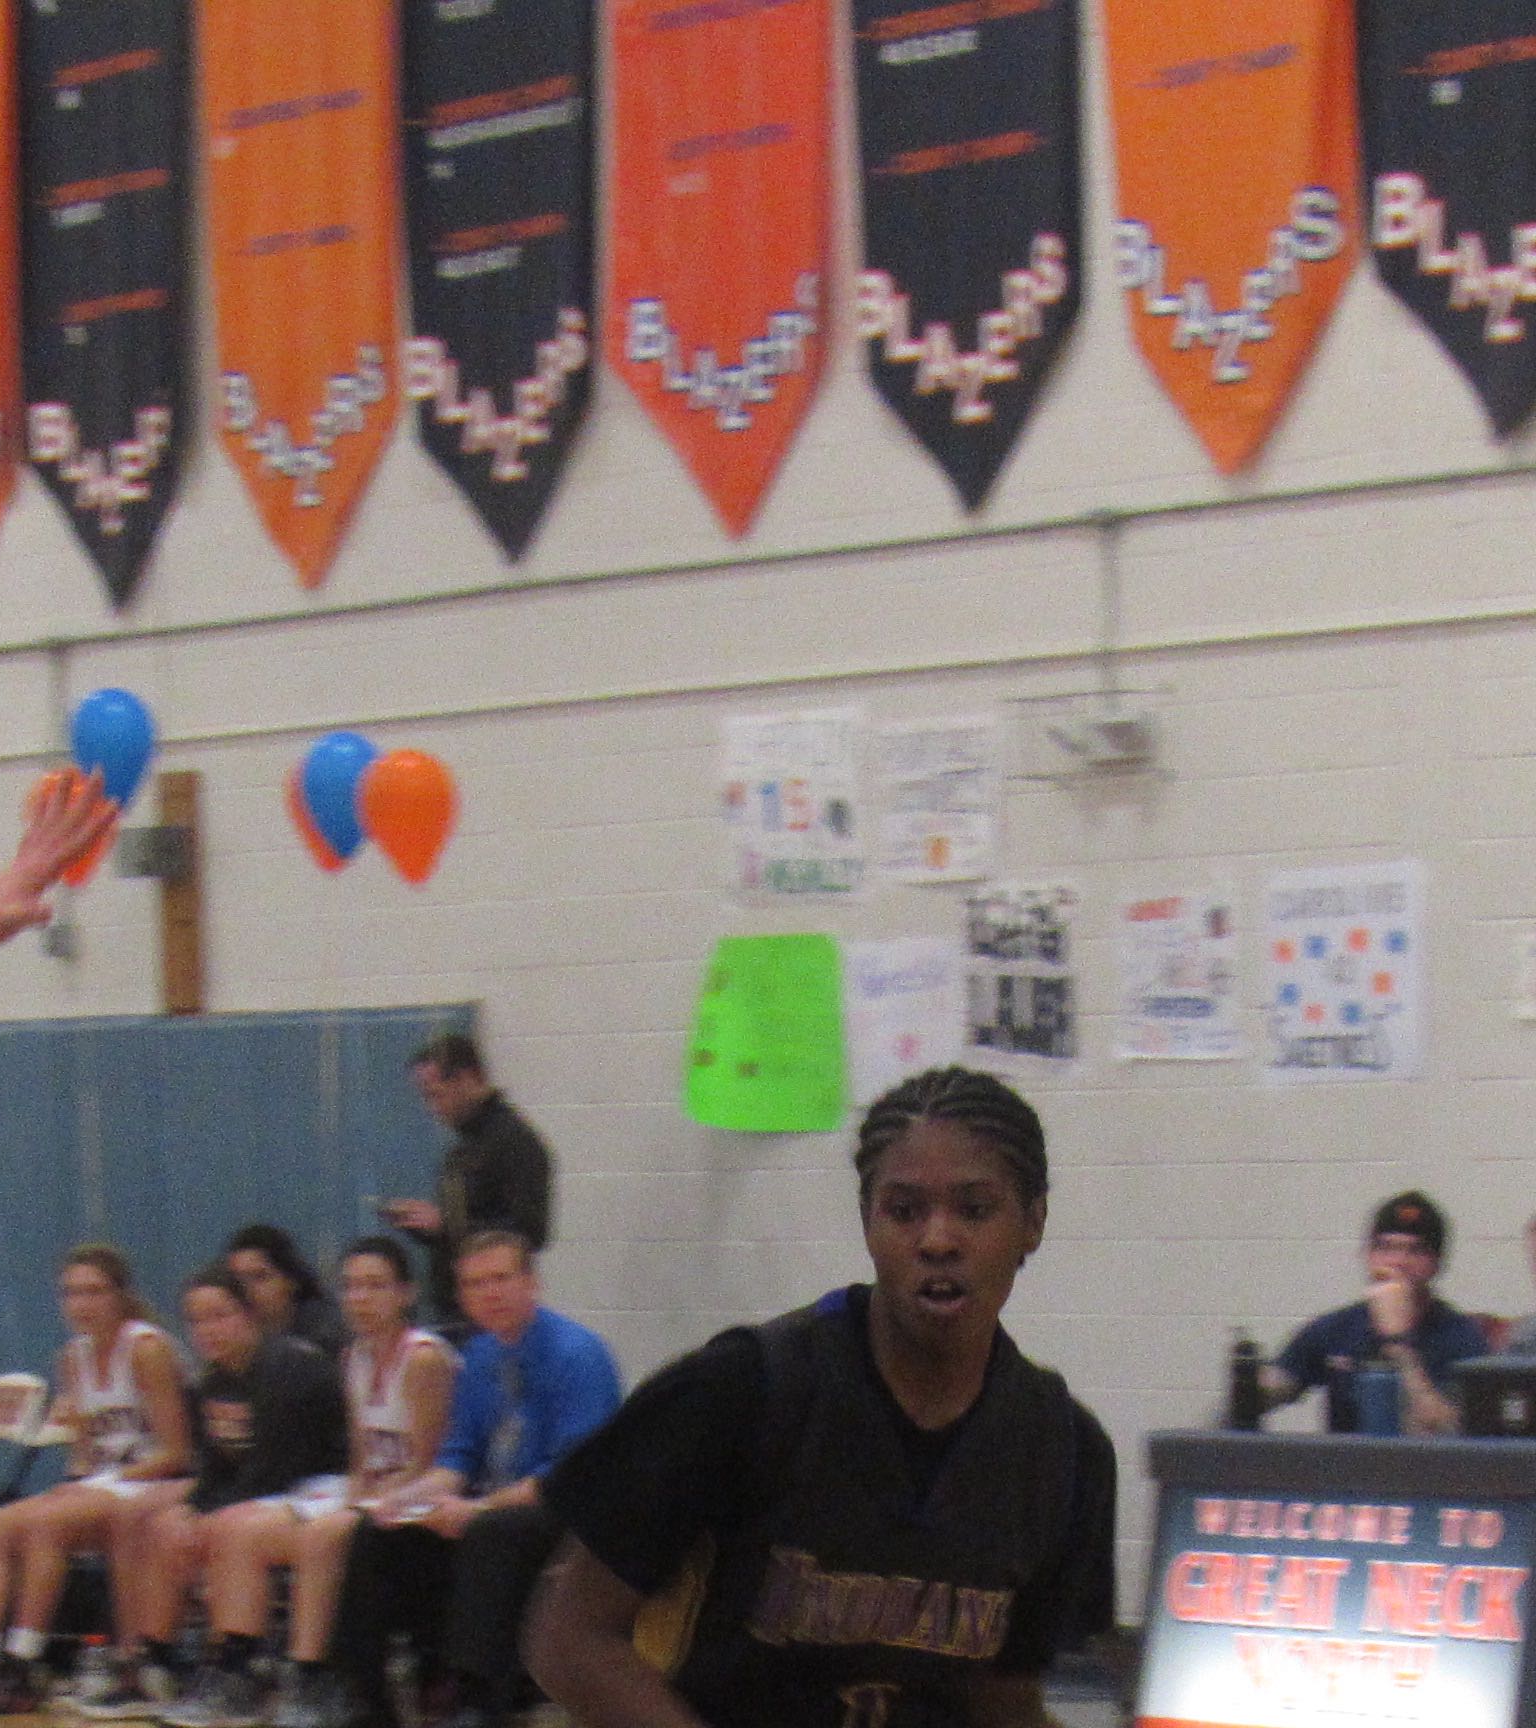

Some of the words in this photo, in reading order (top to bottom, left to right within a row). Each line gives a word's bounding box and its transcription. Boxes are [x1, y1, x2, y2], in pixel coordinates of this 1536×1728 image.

[858, 232, 1067, 423] BLAZERS
[1113, 186, 1343, 383] BLAZERS
[1194, 1498, 1414, 1545] WELCOME
[1438, 1507, 1504, 1548] TO
[1166, 1550, 1352, 1631] GREAT
[1360, 1559, 1533, 1643] NECK
